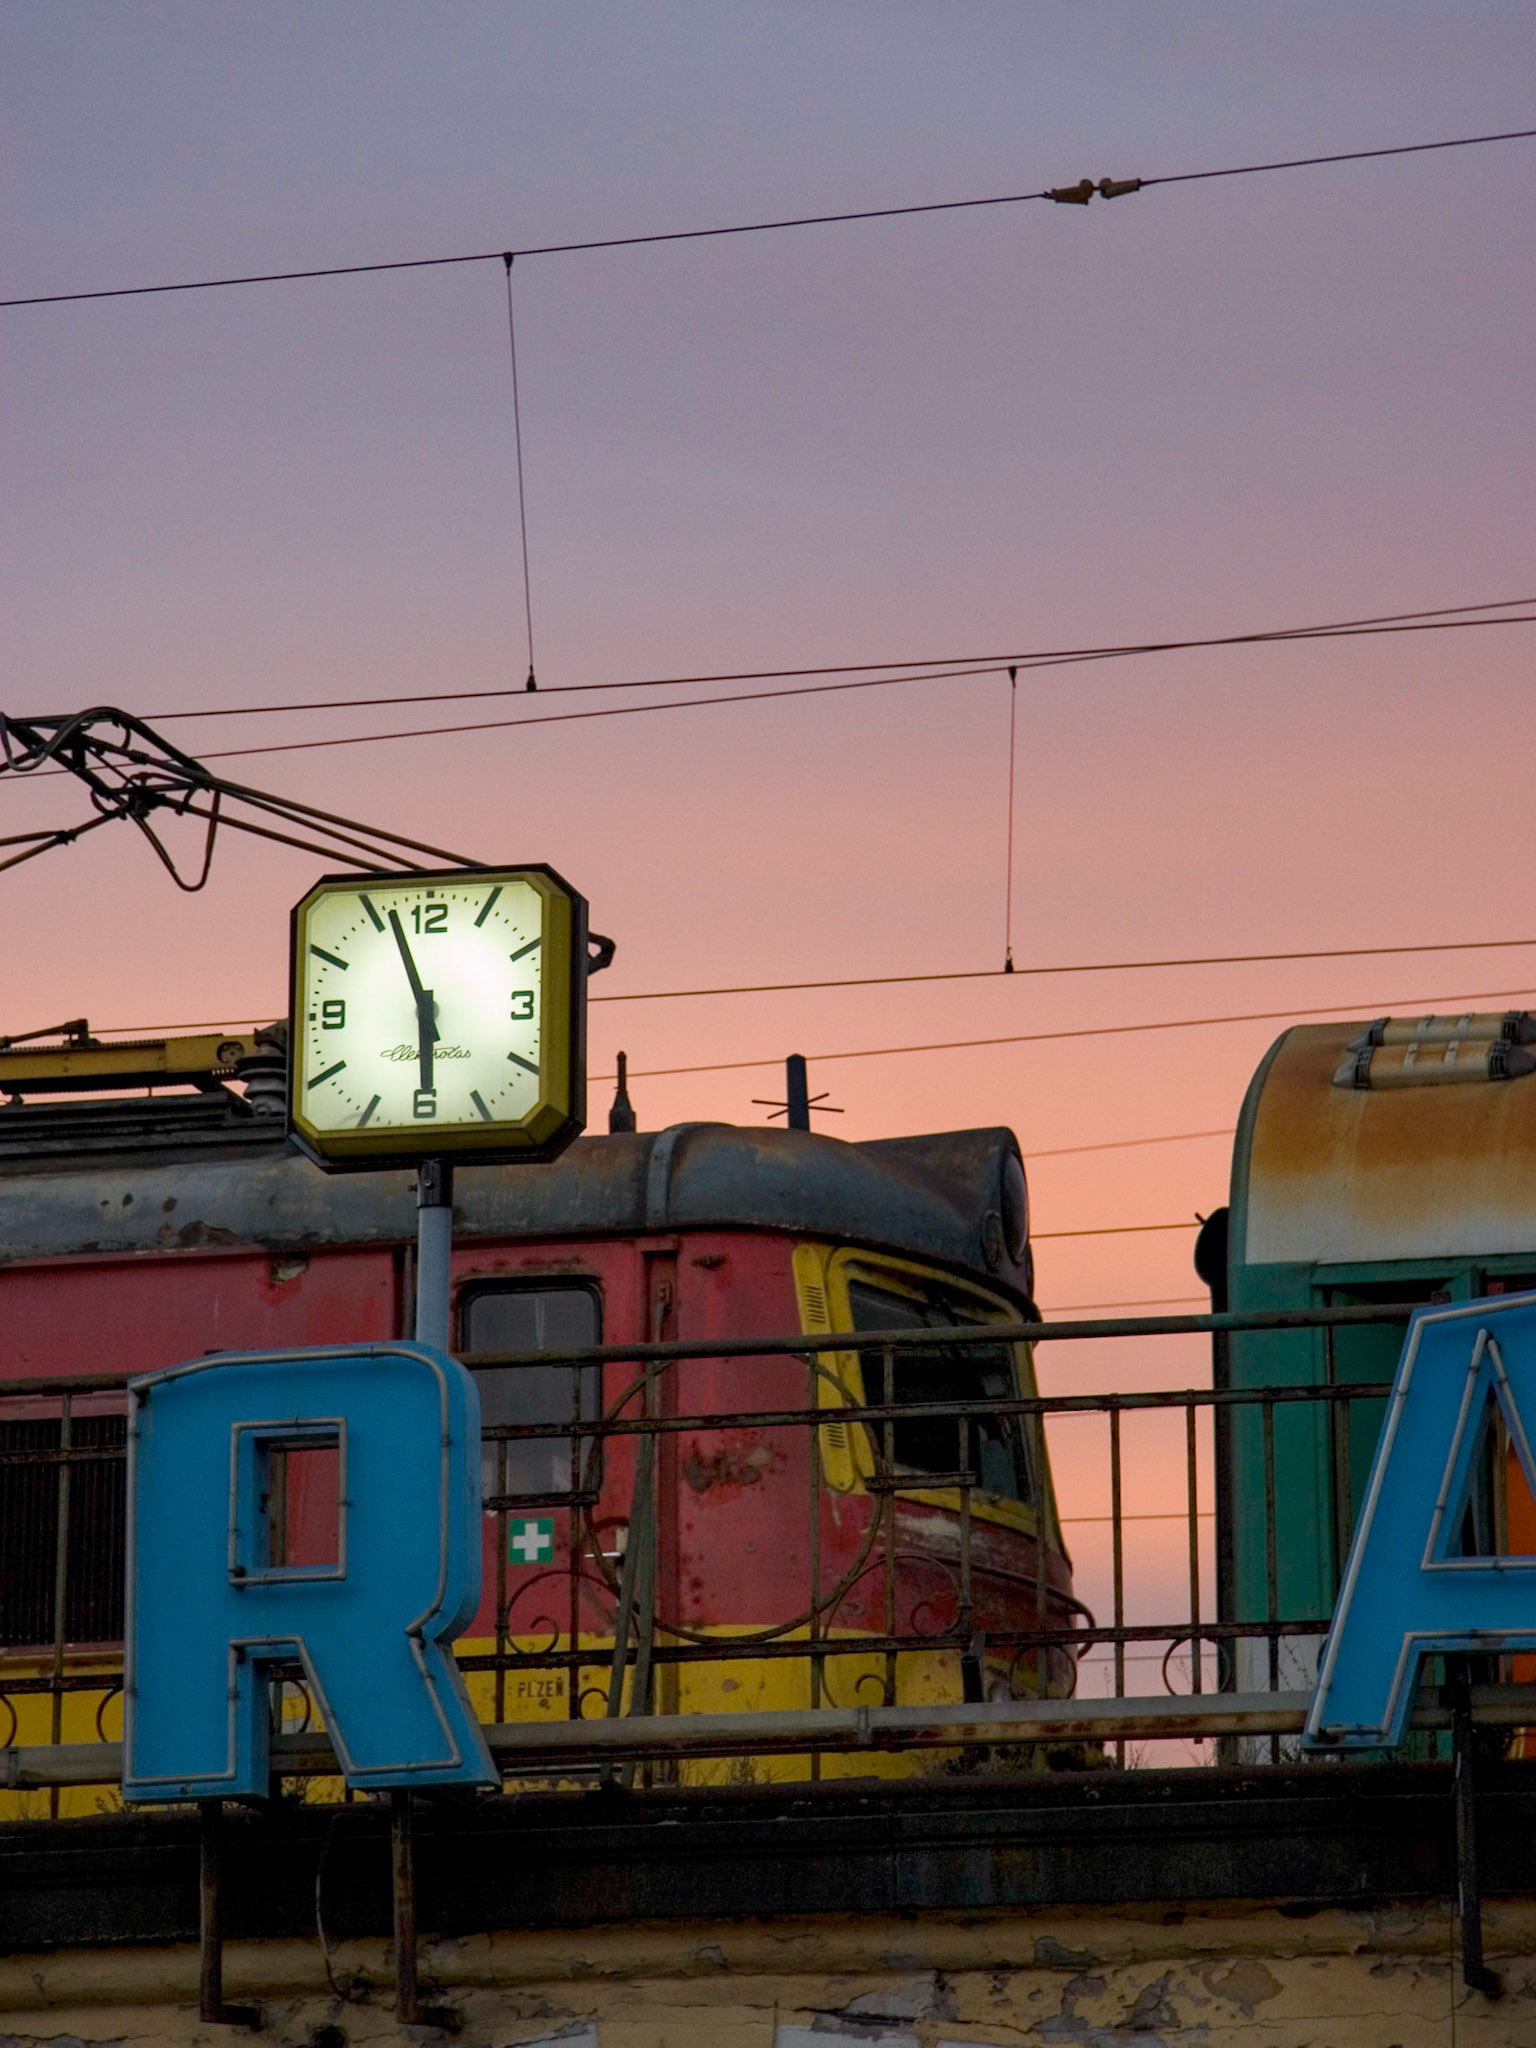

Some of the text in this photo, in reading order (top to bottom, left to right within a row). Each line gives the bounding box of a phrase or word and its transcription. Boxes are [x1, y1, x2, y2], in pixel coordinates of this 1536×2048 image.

[411, 904, 448, 934] 12
[322, 1000, 345, 1029] 9
[510, 990, 535, 1020] 3
[380, 1044, 471, 1062] Eleročas
[413, 1088, 437, 1119] 6
[123, 1340, 499, 1800] R
[518, 1677, 564, 1698] PLZEŇ
